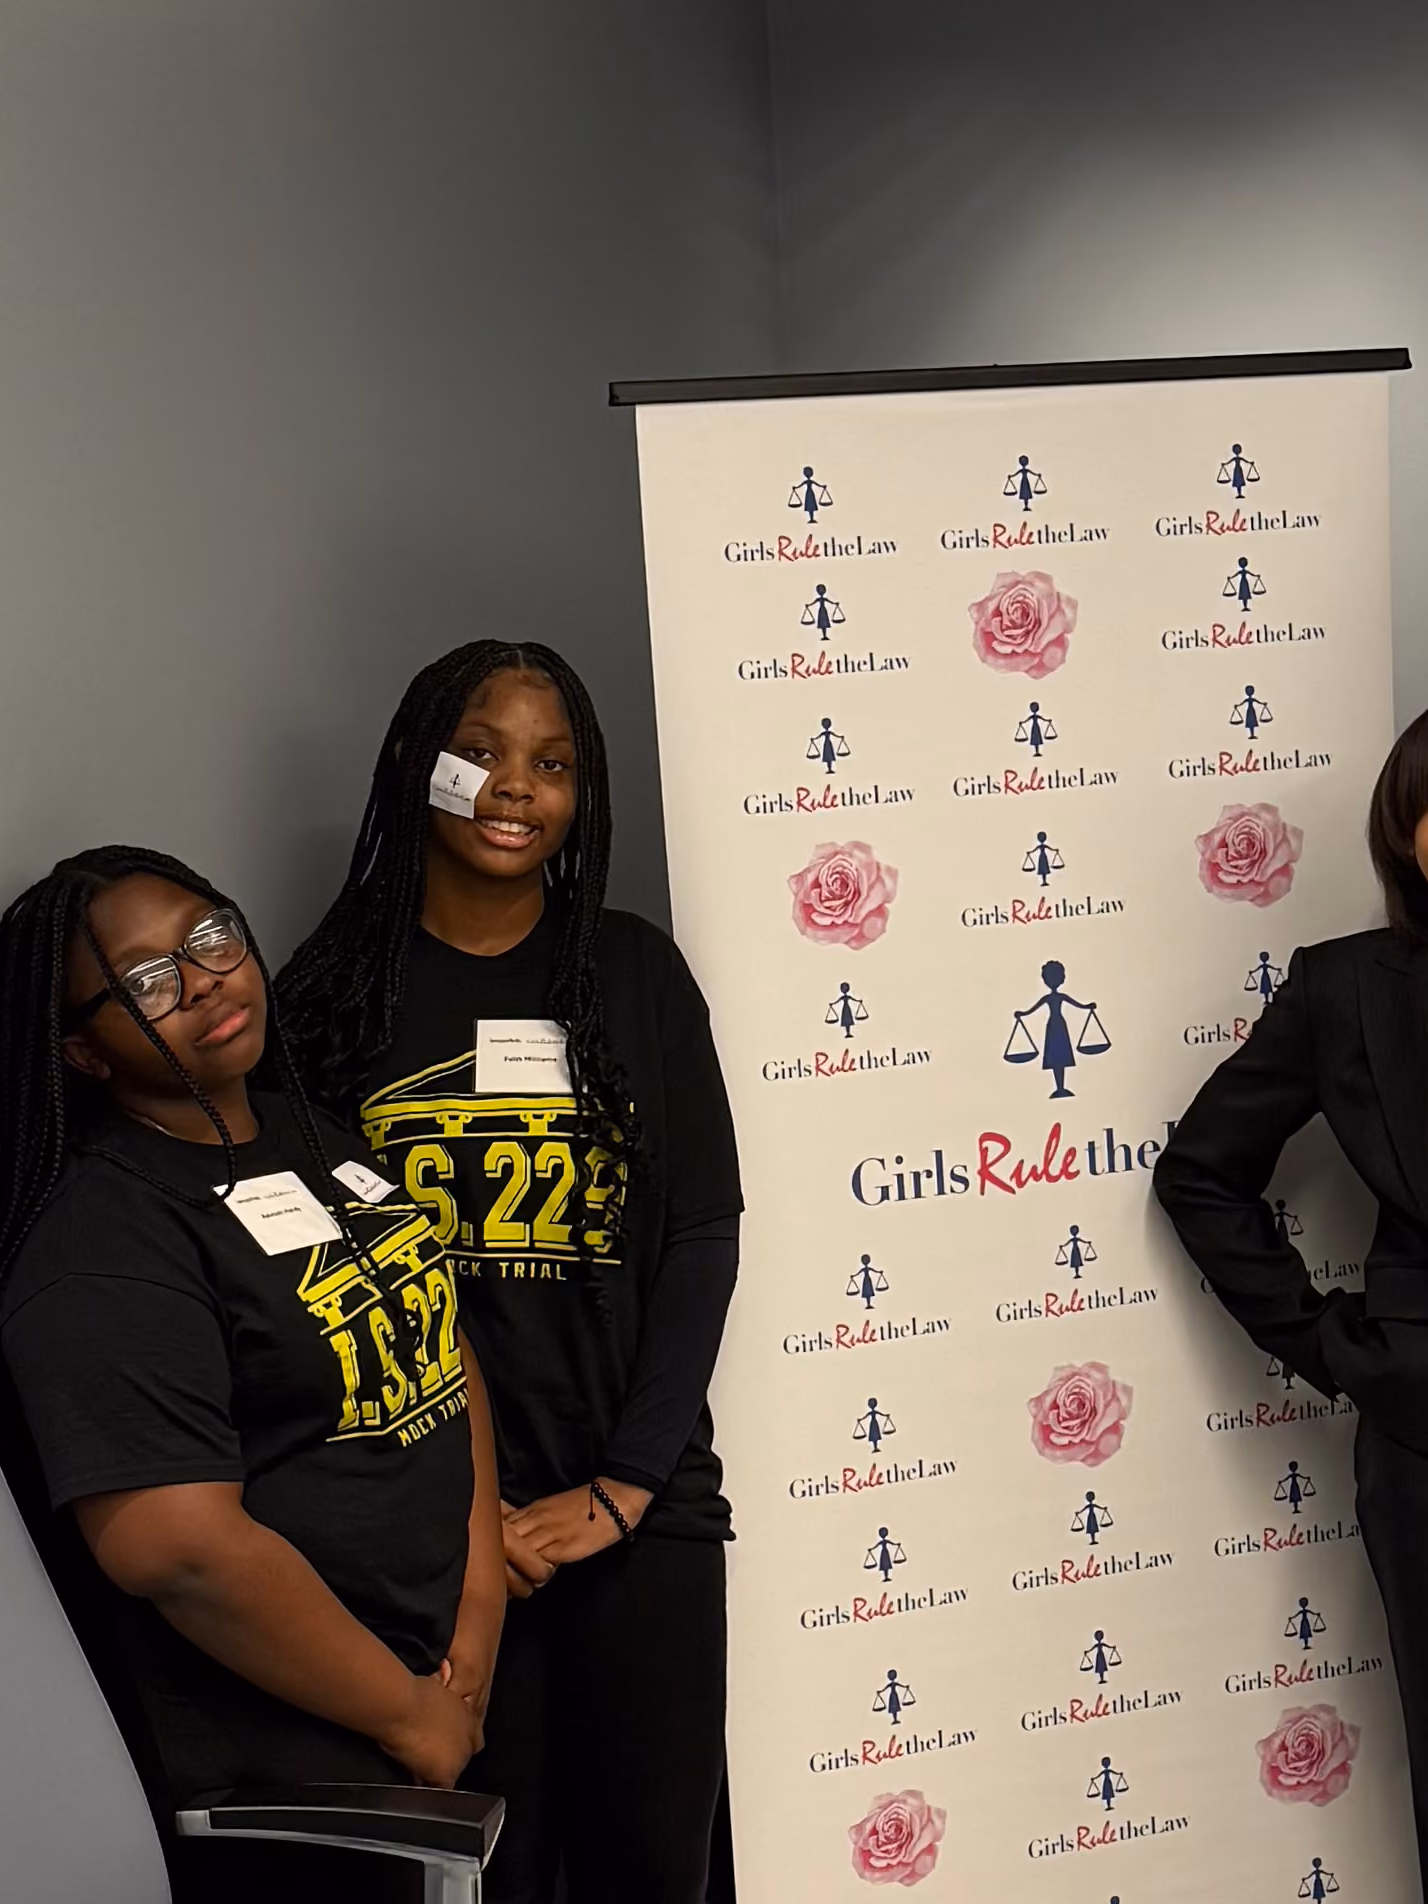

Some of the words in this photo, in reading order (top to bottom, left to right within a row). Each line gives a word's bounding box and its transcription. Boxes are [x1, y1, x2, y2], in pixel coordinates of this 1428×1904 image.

[940, 520, 1109, 550] GirlsRuletheLaw
[1155, 507, 1321, 537] GirlsRuletheLaw
[724, 533, 898, 563] GirlsRuletheLaw
[1161, 620, 1326, 650] GirlsRuletheLaw
[737, 650, 910, 681] GirlsRuletheLaw
[1168, 748, 1332, 779] GirlsRuletheLaw
[952, 766, 1118, 797] GirlsRuletheLaw
[743, 783, 914, 815] GirlsRuletheLaw
[961, 895, 1125, 928] GirlsRuletheLaw
[762, 1047, 931, 1081] GirlsRuletheLaw
[499, 1261, 568, 1282] TRIAL
[995, 1286, 1158, 1323] GirlsRuletheLaw
[782, 1316, 951, 1355] GirlsRuletheLaw
[438, 1388, 469, 1421] TRIA
[1206, 1399, 1354, 1432] GirlsRuletheLa
[788, 1458, 957, 1499] GirlsRuletheLaw
[1214, 1520, 1360, 1557] GirlsRuletheLa
[1012, 1551, 1174, 1591] GirlsRuletheLaw
[800, 1587, 968, 1629] GirlsRuletheLaw
[1224, 1656, 1383, 1694] GirlsRuletheLaw
[1020, 1689, 1182, 1732] GirlsRuletheLaw
[809, 1729, 977, 1773] GirlsRuletheLaw
[1028, 1815, 1190, 1859] GirlsRuletheLaw
